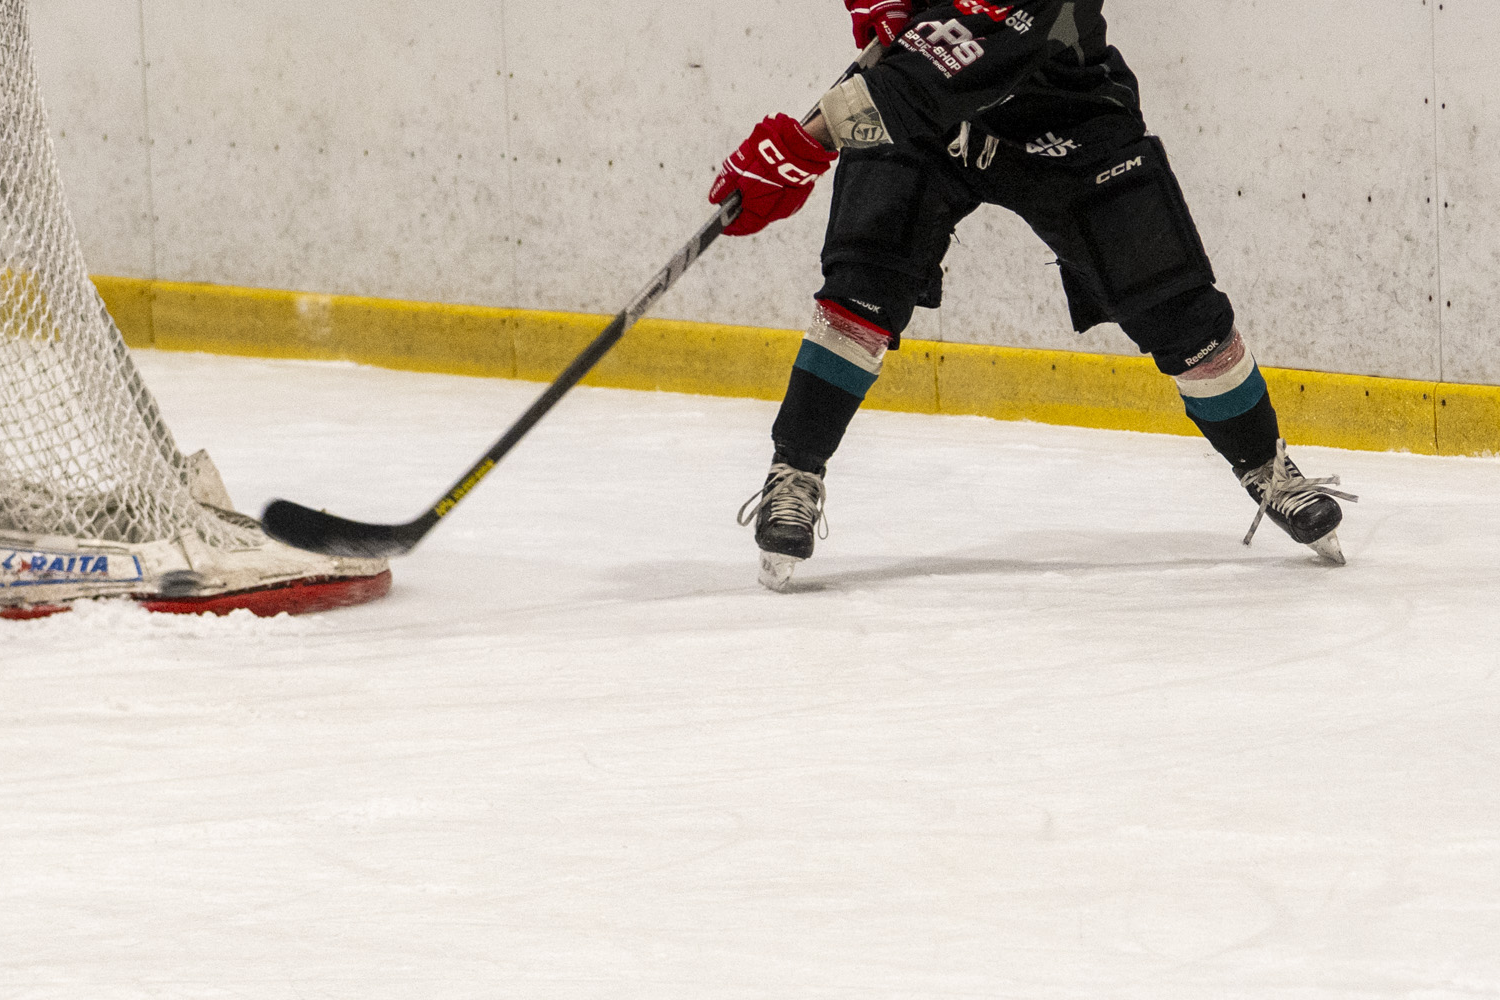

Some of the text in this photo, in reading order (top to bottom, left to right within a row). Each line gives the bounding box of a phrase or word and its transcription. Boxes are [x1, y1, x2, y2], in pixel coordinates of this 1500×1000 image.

[1005, 17, 1030, 35] OUT
[1013, 9, 1034, 27] ALL
[1096, 155, 1142, 184] CCM
[1184, 339, 1219, 367] Reebok
[31, 555, 108, 573] RAITA
